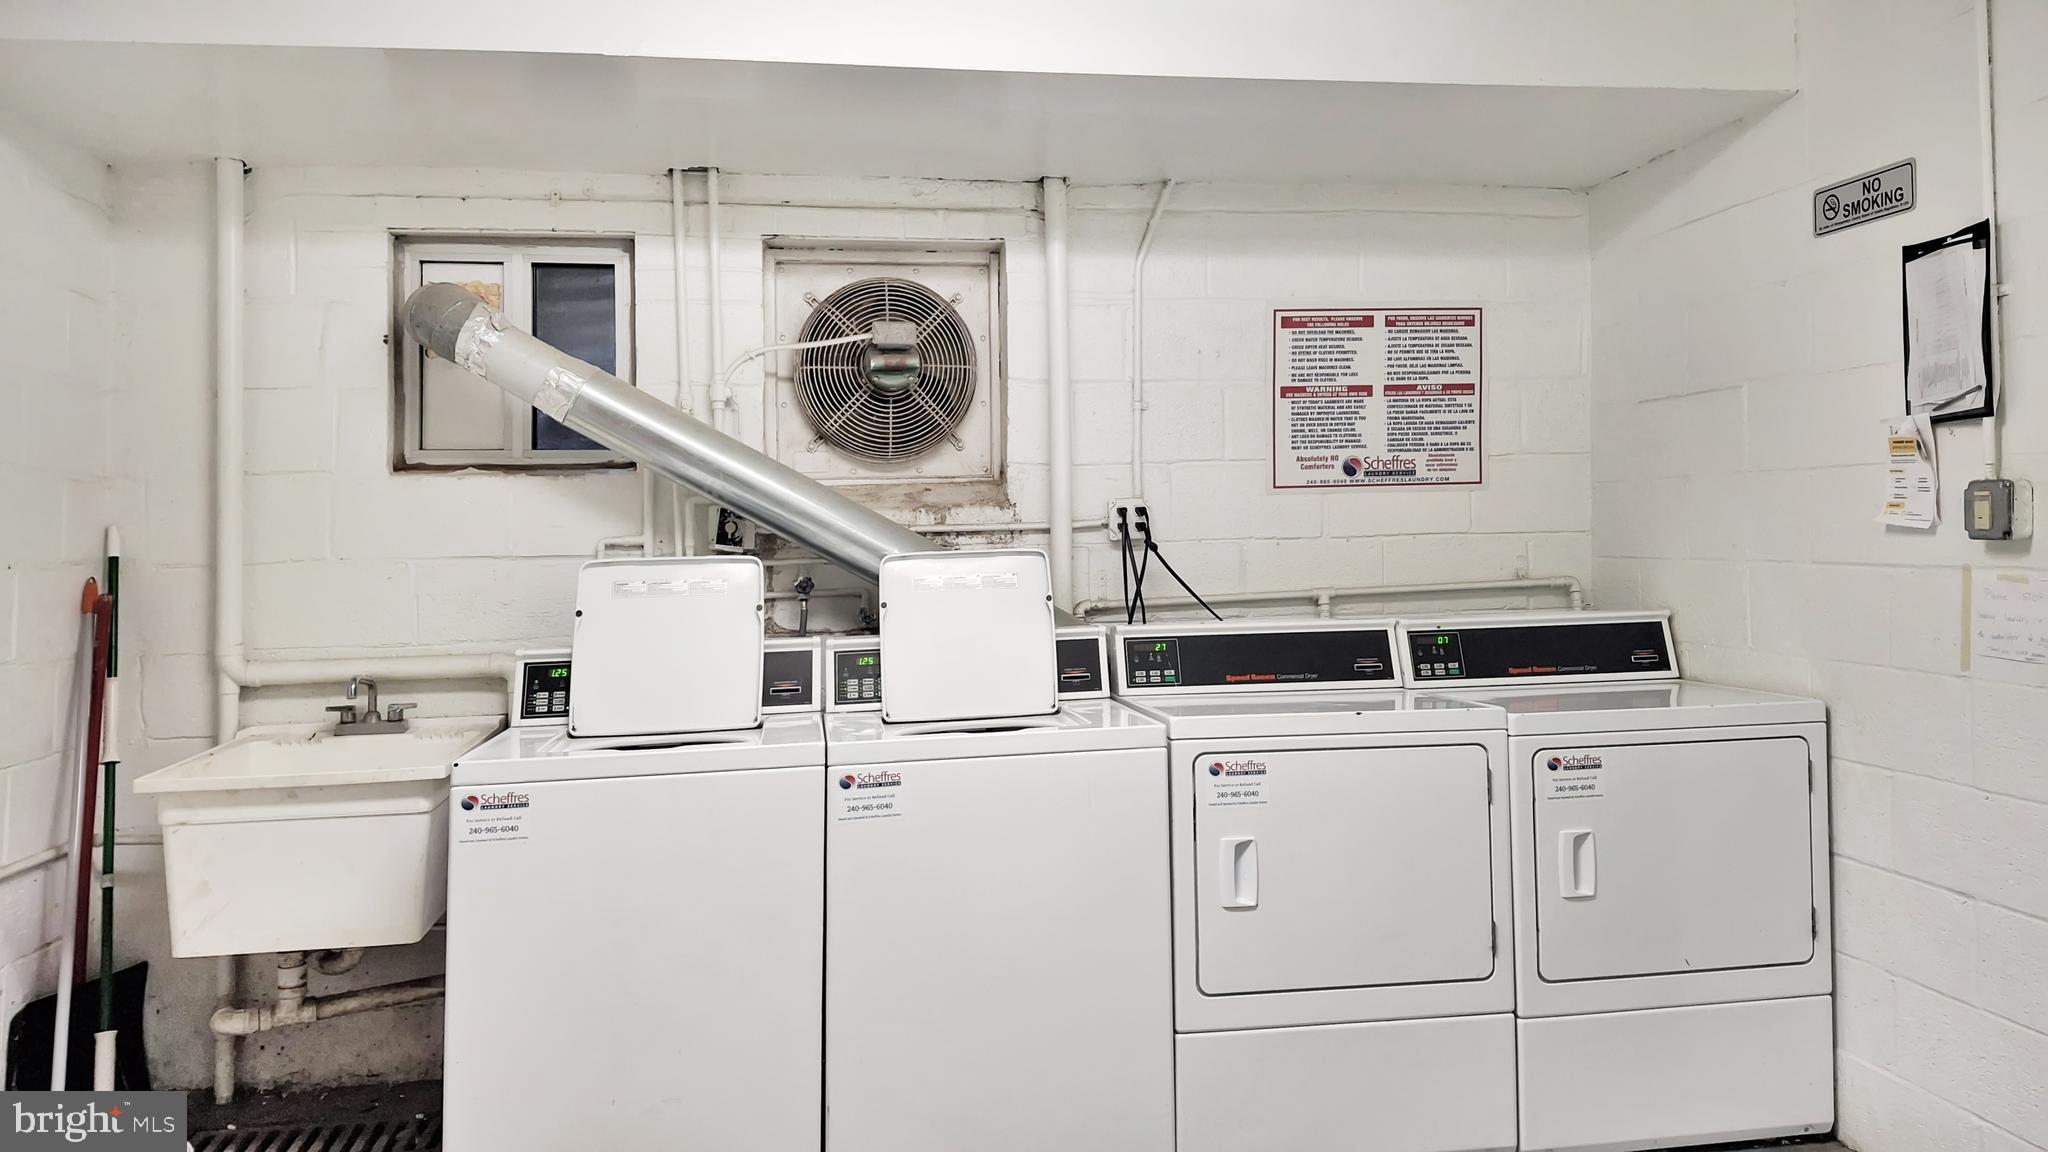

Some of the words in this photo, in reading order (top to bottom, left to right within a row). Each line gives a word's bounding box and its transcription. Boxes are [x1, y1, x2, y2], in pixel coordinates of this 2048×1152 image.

[1862, 177, 1881, 196] NO
[1842, 186, 1904, 218] SMOKING
[1364, 455, 1416, 470] Scheffres
[1437, 636, 1448, 644] 07
[1155, 643, 1166, 651] 27
[1563, 755, 1602, 765] Scheffres
[1225, 760, 1266, 771] Scheffres
[857, 771, 901, 783] Scheffres
[1555, 784, 1595, 792] 240-965-6040
[481, 792, 529, 805] Scheffres
[847, 803, 893, 812] 240-965-6040
[469, 825, 519, 834] 240-965-6040
